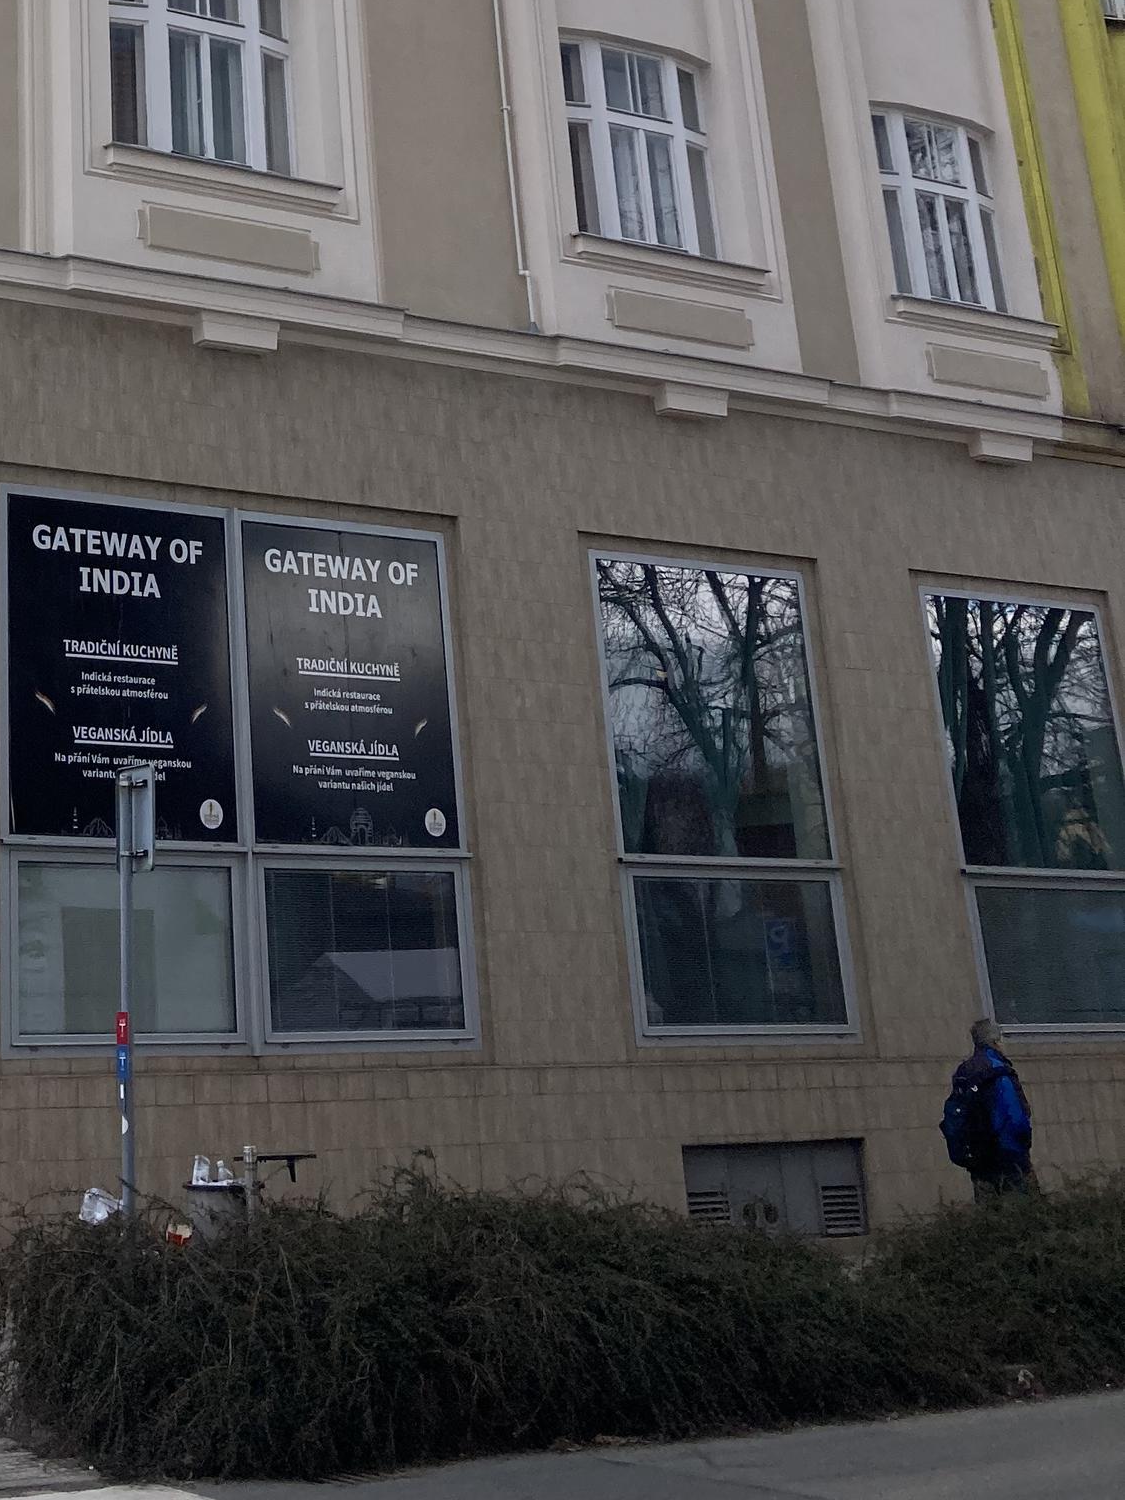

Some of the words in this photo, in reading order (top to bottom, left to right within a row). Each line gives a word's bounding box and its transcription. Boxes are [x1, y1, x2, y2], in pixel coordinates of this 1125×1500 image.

[32, 524, 162, 560] GATEWAY
[169, 538, 203, 564] OF
[264, 548, 381, 582] GATEWAY
[388, 561, 419, 586] OF
[79, 567, 161, 598] INDIA
[308, 588, 383, 619] INDIA
[63, 639, 120, 656] TRADIČNÍ
[123, 644, 178, 660] KUCHYNĚ
[296, 657, 348, 672] TRADIČNÍ
[350, 662, 401, 677] KUCHYNĚ
[81, 671, 112, 682] Indická
[113, 675, 156, 685] restaurace
[70, 686, 75, 694] s
[76, 685, 121, 697] přátelskou
[121, 688, 169, 700] atmosférou
[313, 687, 341, 698] Indická
[342, 691, 381, 701] restaurace
[310, 700, 350, 712] přátelskou
[351, 703, 393, 715] atmosférou
[73, 725, 137, 742] VEGANSKÁ
[139, 727, 174, 744] JÍDLA
[308, 739, 366, 755] VEGANSKÁ
[368, 740, 399, 757] JÍDLA
[54, 752, 66, 762] Na
[68, 752, 90, 765] přání
[91, 753, 110, 764] Vám
[292, 765, 303, 774] Na
[325, 765, 342, 776] Vám
[377, 769, 416, 781] veganskou
[318, 780, 350, 790] variantu
